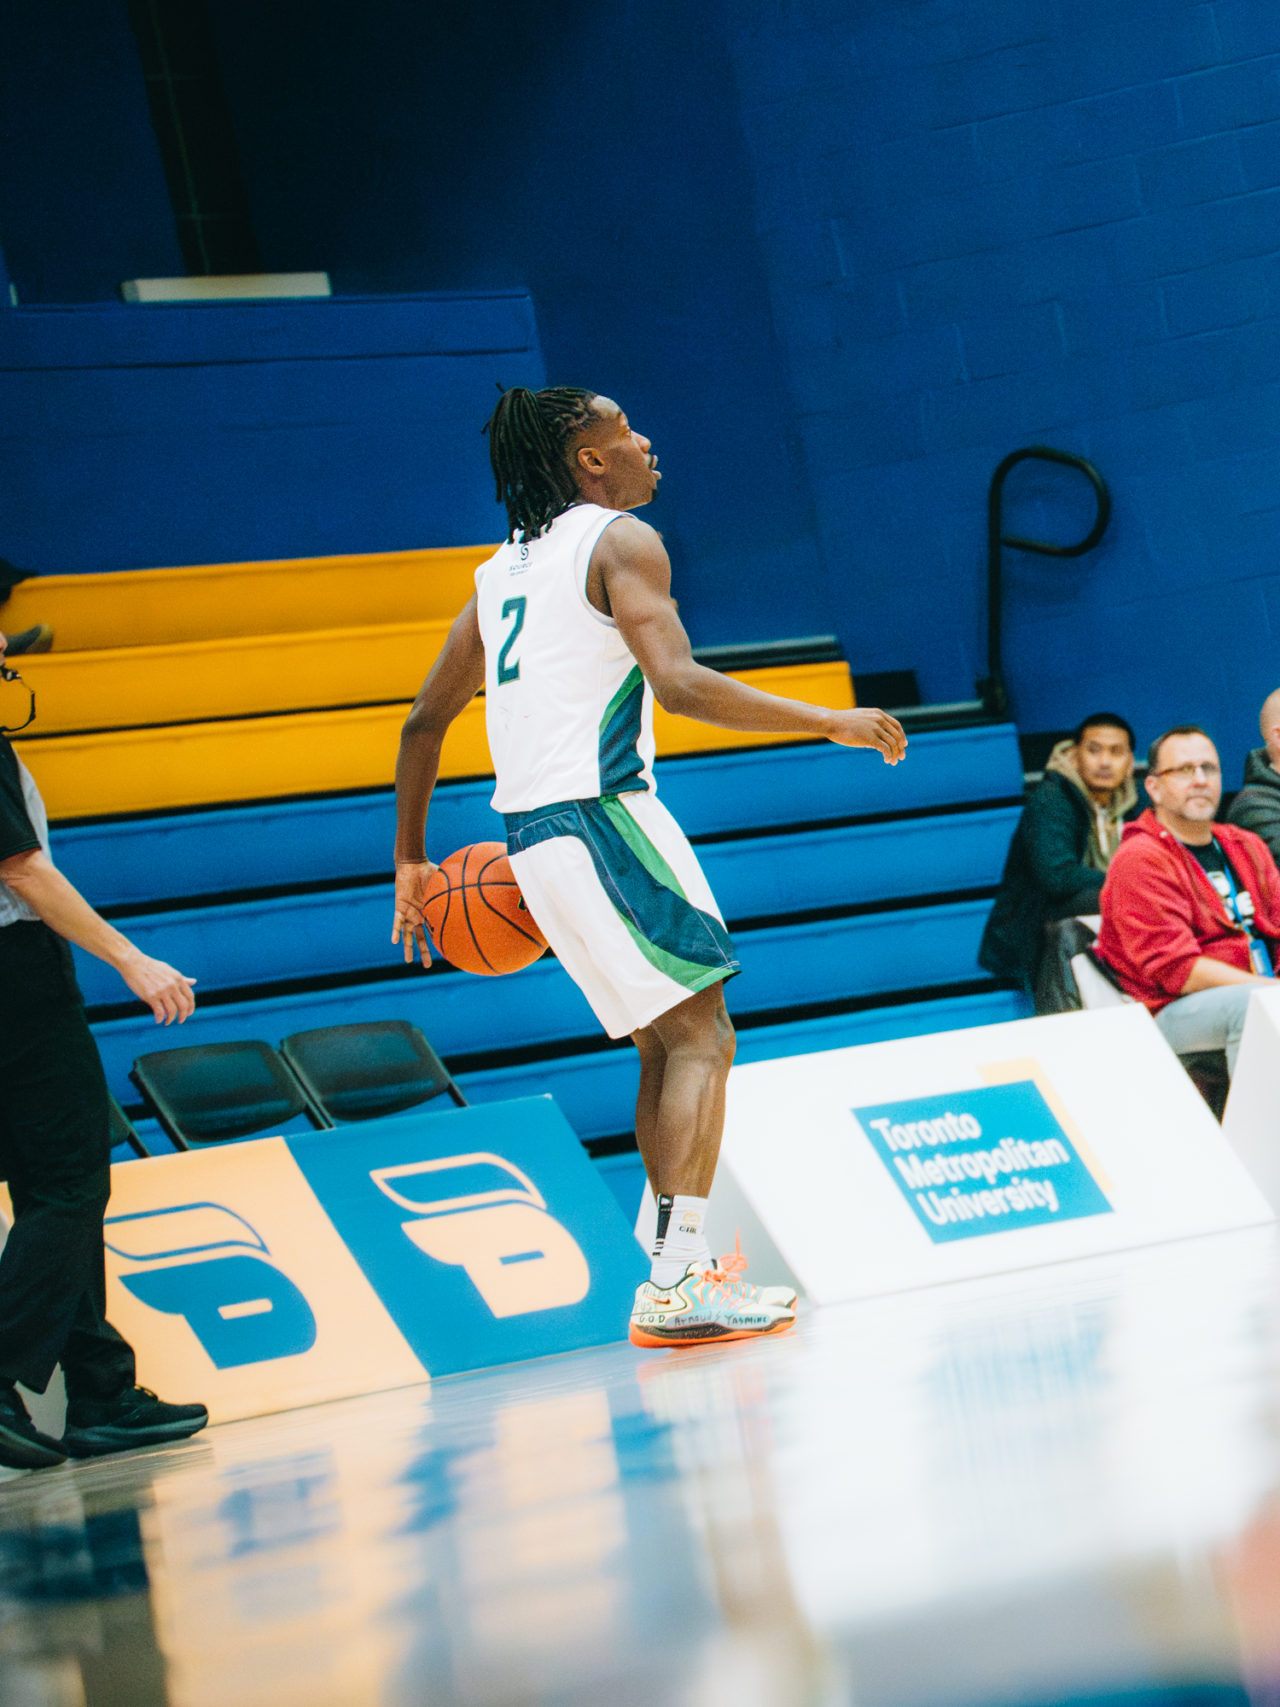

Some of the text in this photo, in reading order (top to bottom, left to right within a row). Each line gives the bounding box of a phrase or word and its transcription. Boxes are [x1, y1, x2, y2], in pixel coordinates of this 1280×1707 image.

[497, 594, 527, 687] 2
[869, 1111, 982, 1153] Toronto
[893, 1137, 1071, 1186] Metropolitan
[915, 1176, 1060, 1226] University
